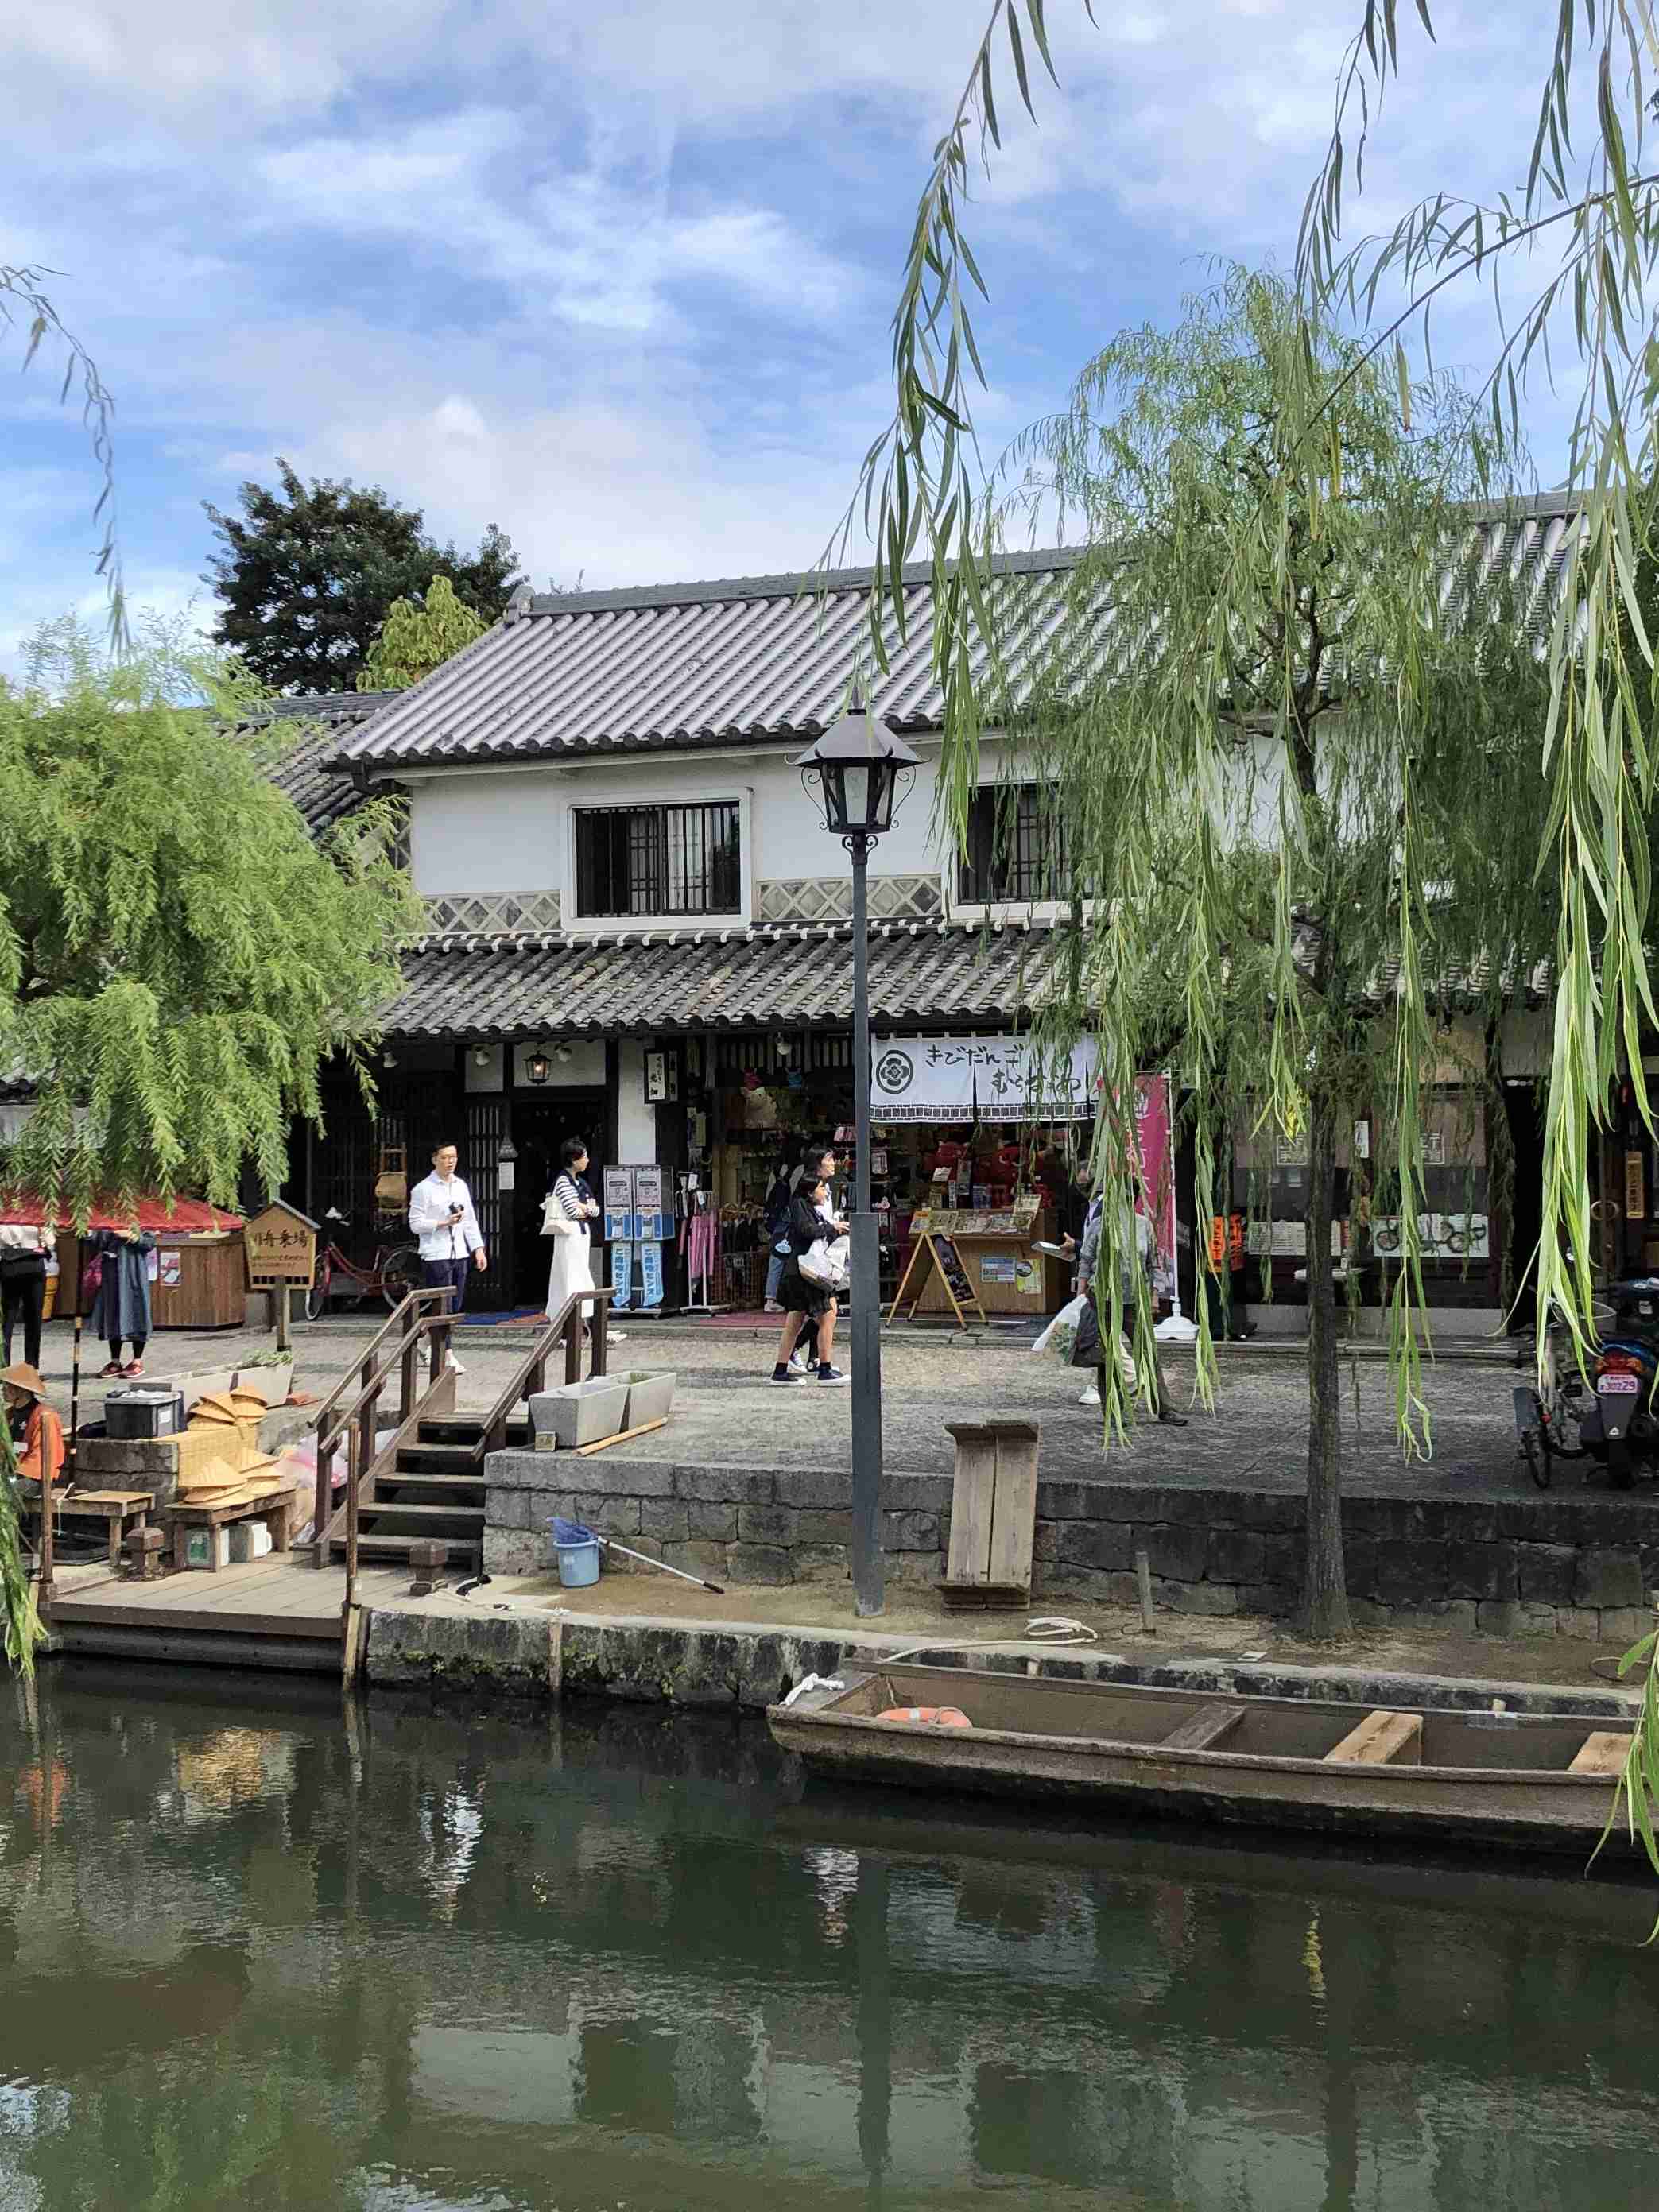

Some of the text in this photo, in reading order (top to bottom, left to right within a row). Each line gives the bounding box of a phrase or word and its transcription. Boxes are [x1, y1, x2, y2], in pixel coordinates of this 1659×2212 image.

[925, 1043, 1024, 1068] きびだんご
